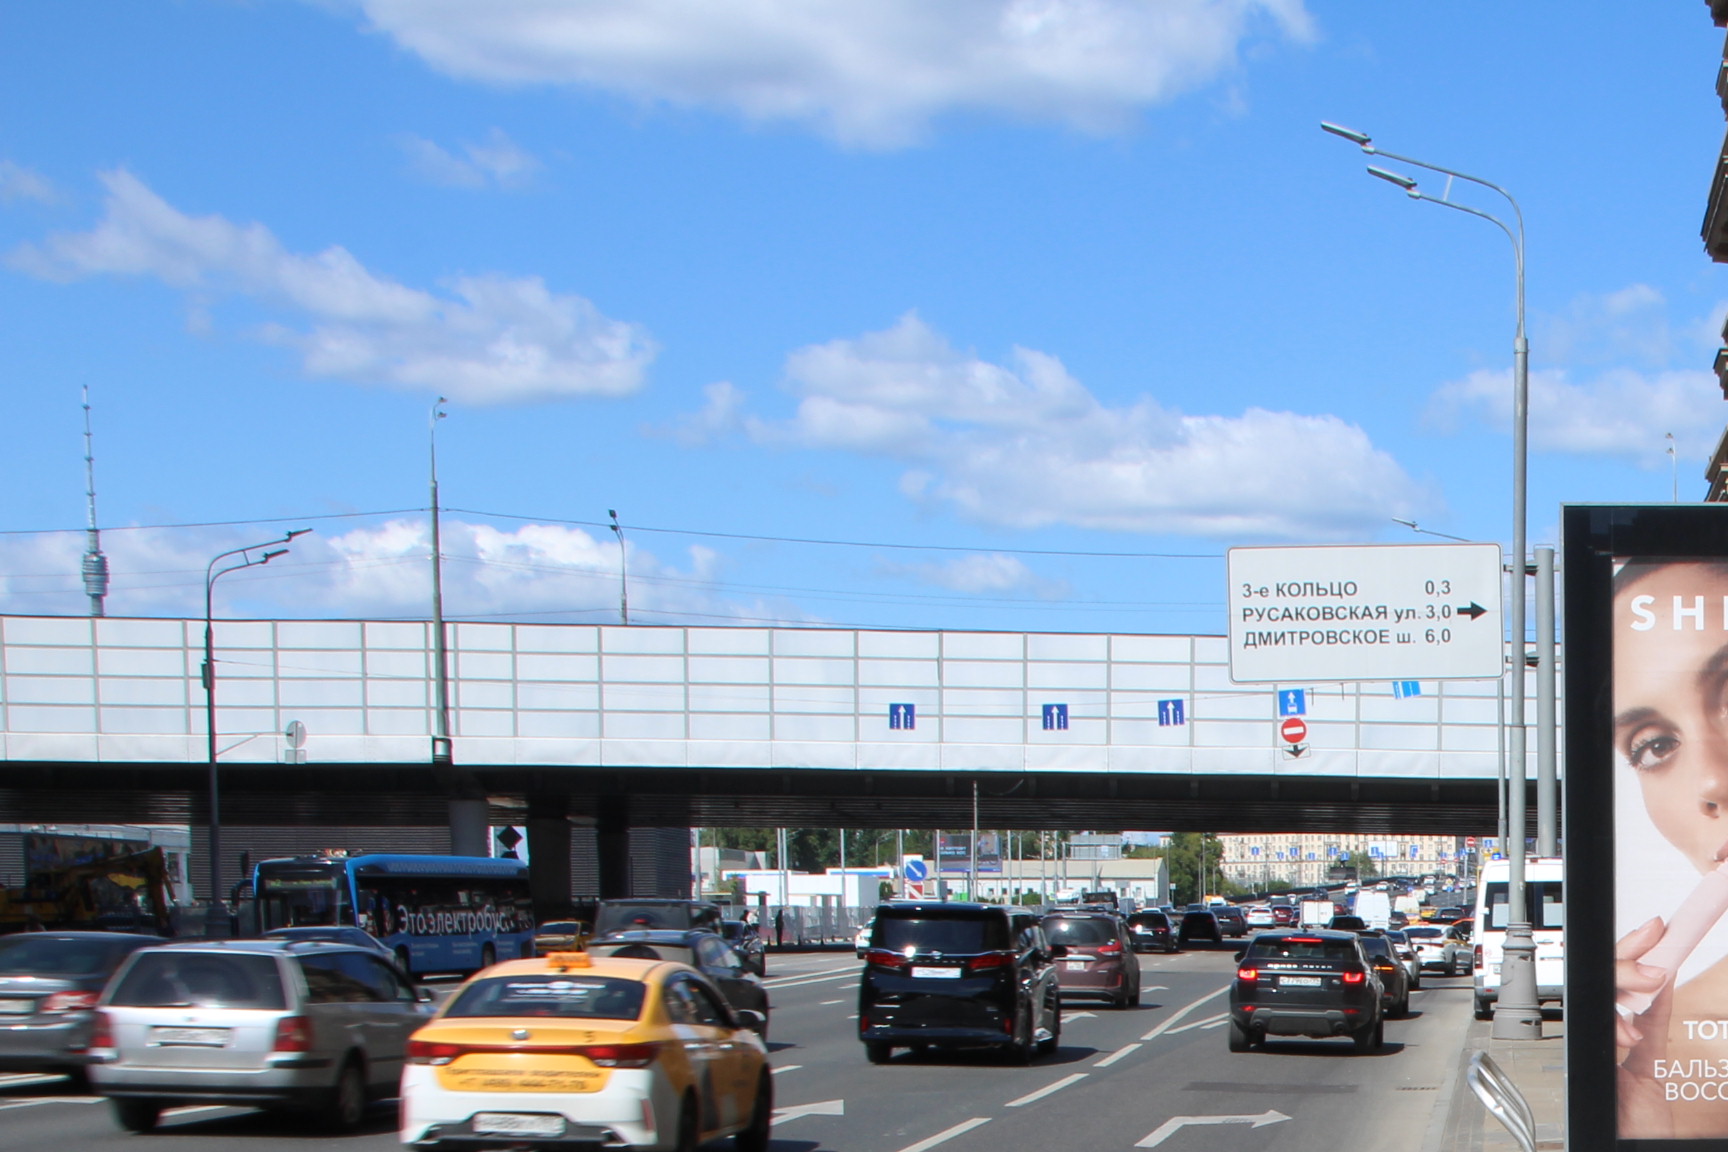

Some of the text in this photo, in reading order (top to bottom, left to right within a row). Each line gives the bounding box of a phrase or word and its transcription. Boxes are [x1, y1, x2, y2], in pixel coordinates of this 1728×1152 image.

[1242, 580, 1451, 599] 3-е КОЛЬЦО 0,3
[1242, 604, 1451, 624] РУСАКОВСКАЯ ул. 3,0
[1243, 628, 1451, 649] ДМИТРОВСКОЕ ш. 6,0
